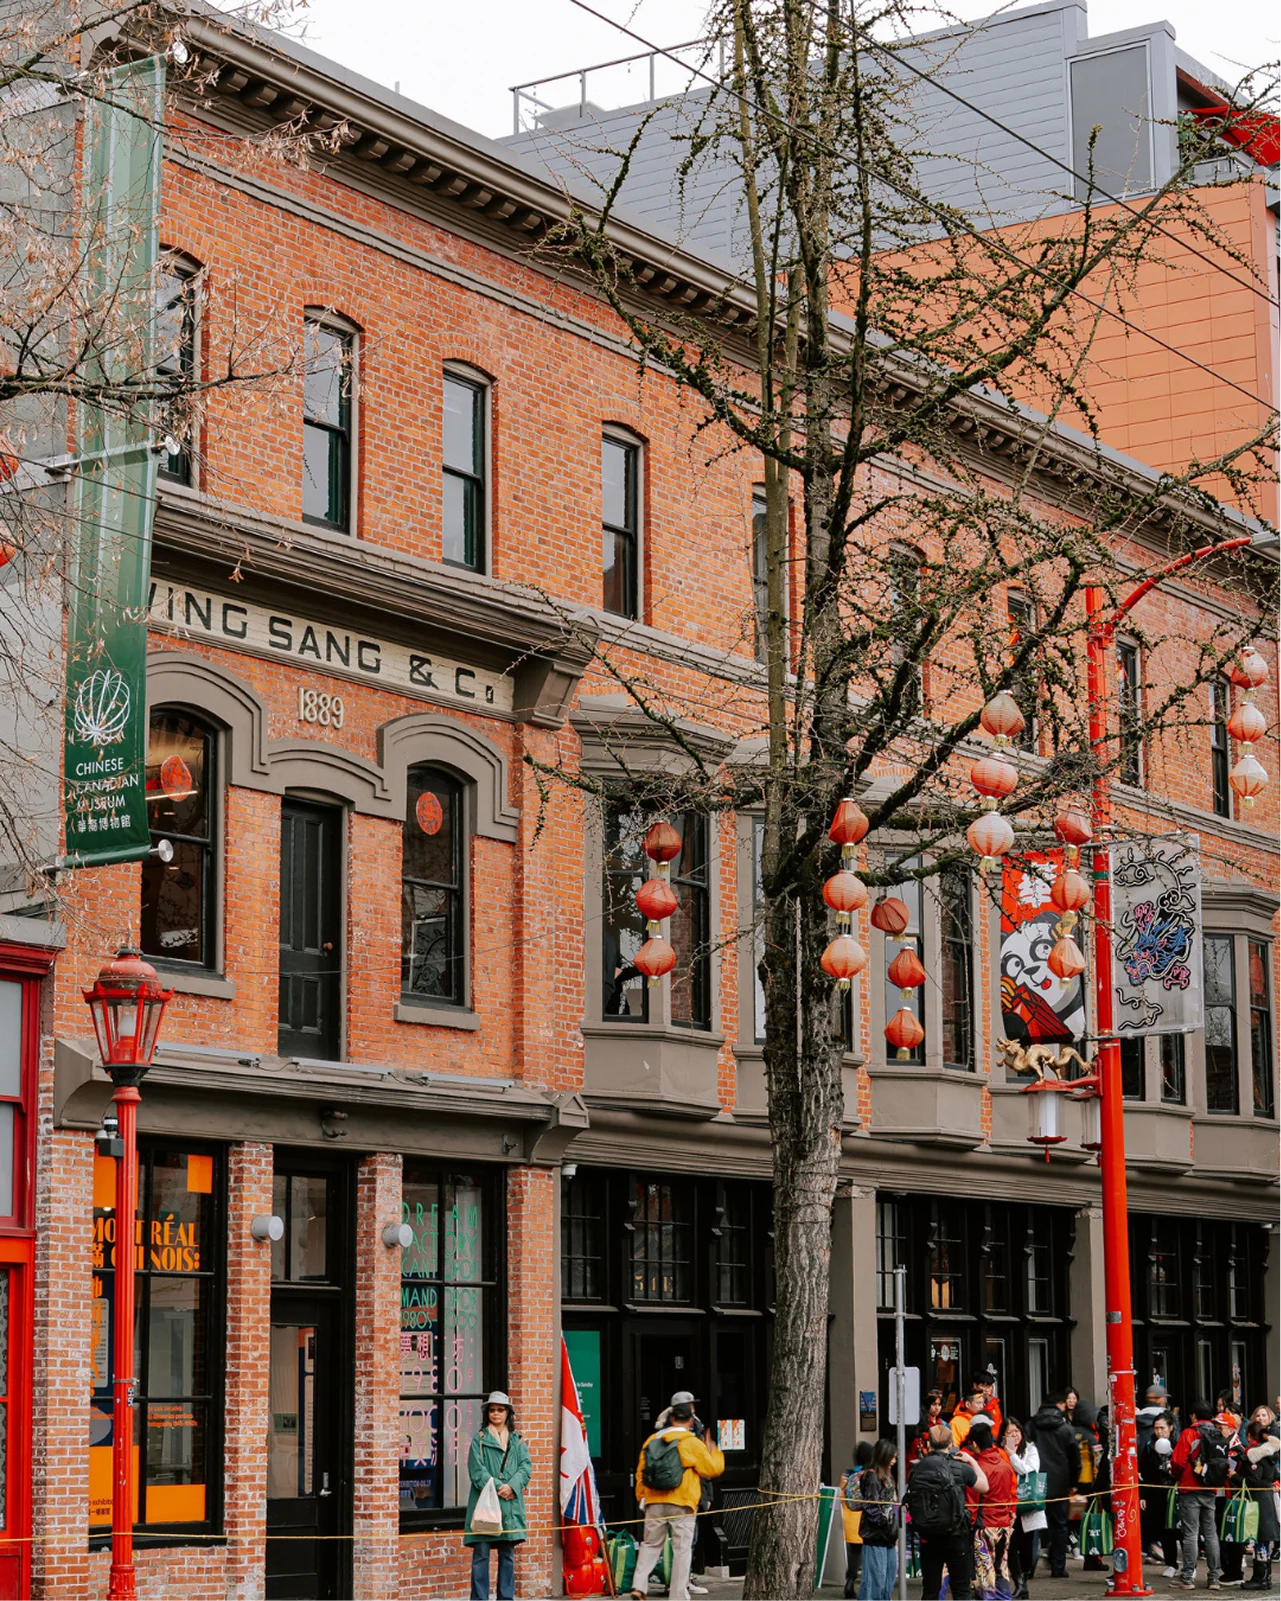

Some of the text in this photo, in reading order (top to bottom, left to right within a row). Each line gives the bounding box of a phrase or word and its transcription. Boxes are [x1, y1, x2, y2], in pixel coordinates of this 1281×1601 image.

[268, 615, 381, 674] SANG
[409, 653, 439, 690] &
[298, 686, 345, 729] 1889
[75, 757, 124, 776] CHINESE
[401, 1202, 478, 1229] DREAM
[401, 1230, 478, 1257] ACTORY
